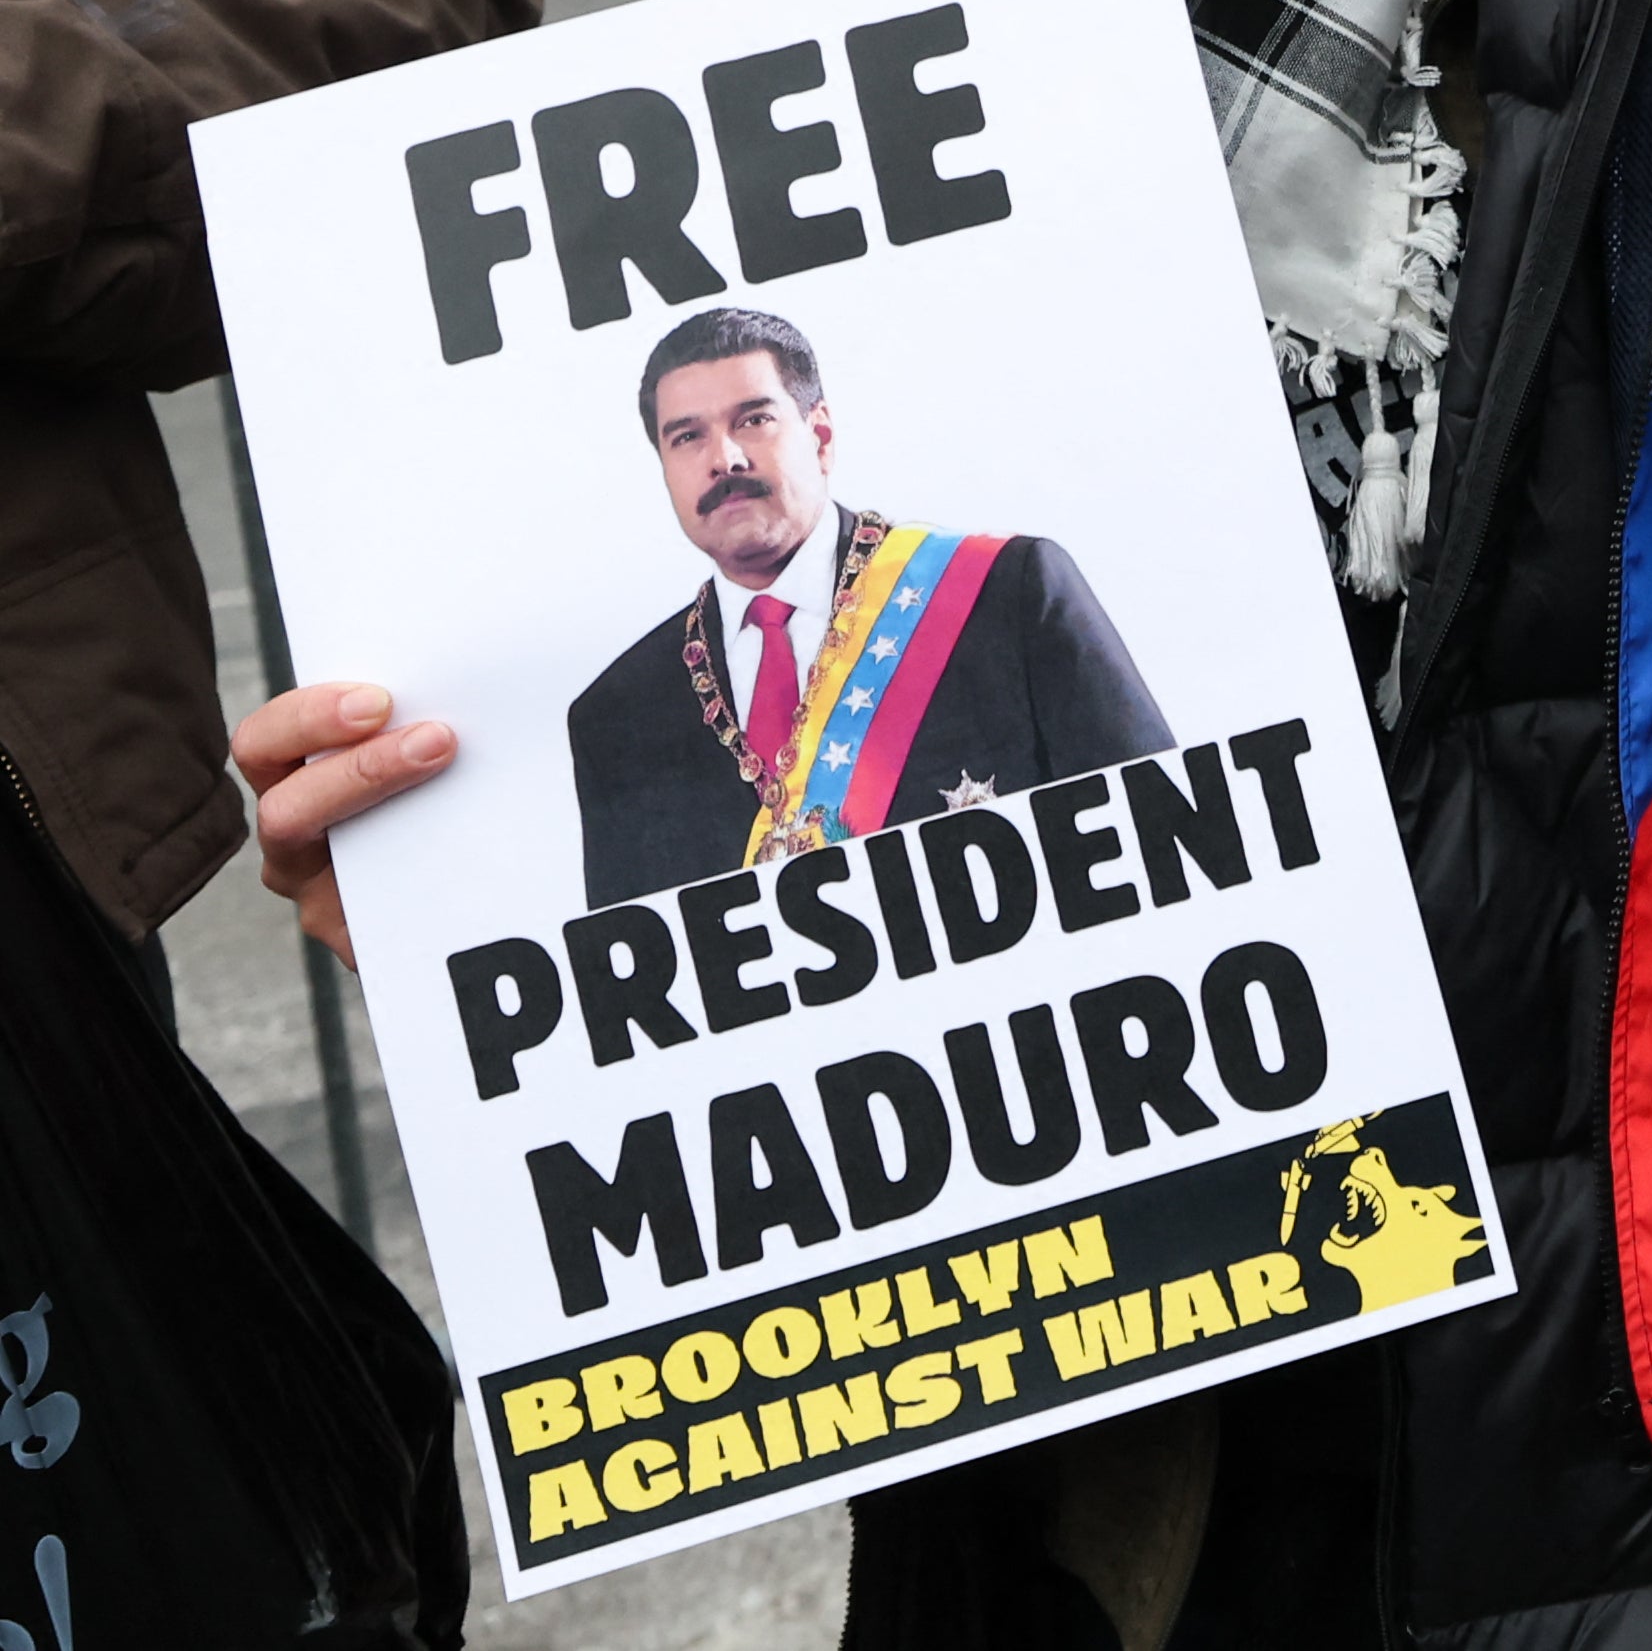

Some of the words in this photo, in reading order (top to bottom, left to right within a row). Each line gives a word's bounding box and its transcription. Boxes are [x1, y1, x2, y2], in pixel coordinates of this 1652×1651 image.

[403, 2, 1012, 366] FREE
[446, 717, 1319, 1102] PRESIDENT
[525, 940, 1329, 1318] MADURO
[501, 1214, 1115, 1457] BROOKLYN
[527, 1328, 1024, 1543] AGAINST
[1044, 1251, 1309, 1383] WAR
